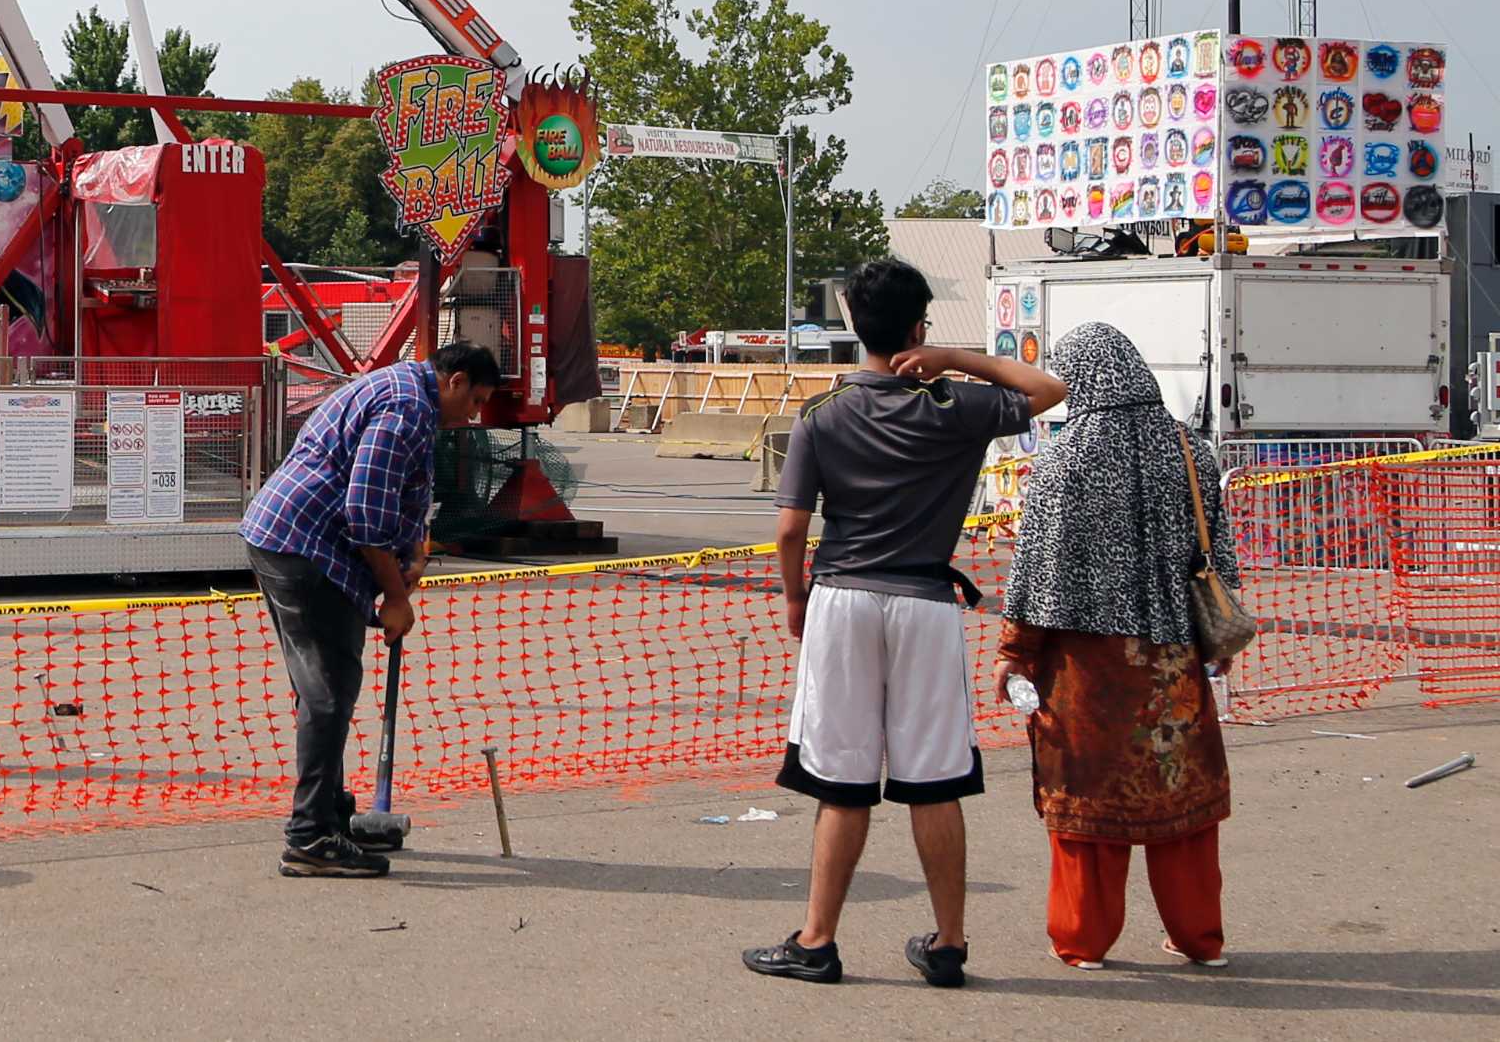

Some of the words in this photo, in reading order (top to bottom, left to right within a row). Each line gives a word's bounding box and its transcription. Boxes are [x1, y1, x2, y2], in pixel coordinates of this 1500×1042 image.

[537, 129, 567, 143] FIRE
[646, 130, 664, 138] VISIT
[664, 130, 677, 139] THE
[547, 143, 580, 158] BALL
[637, 139, 673, 153] NATURAL
[674, 140, 716, 155] RESOURCES
[716, 142, 736, 156] PARK
[182, 144, 245, 173] ENTER
[399, 145, 505, 226] BALL
[186, 394, 241, 409] ENTER
[159, 474, 176, 487] 038
